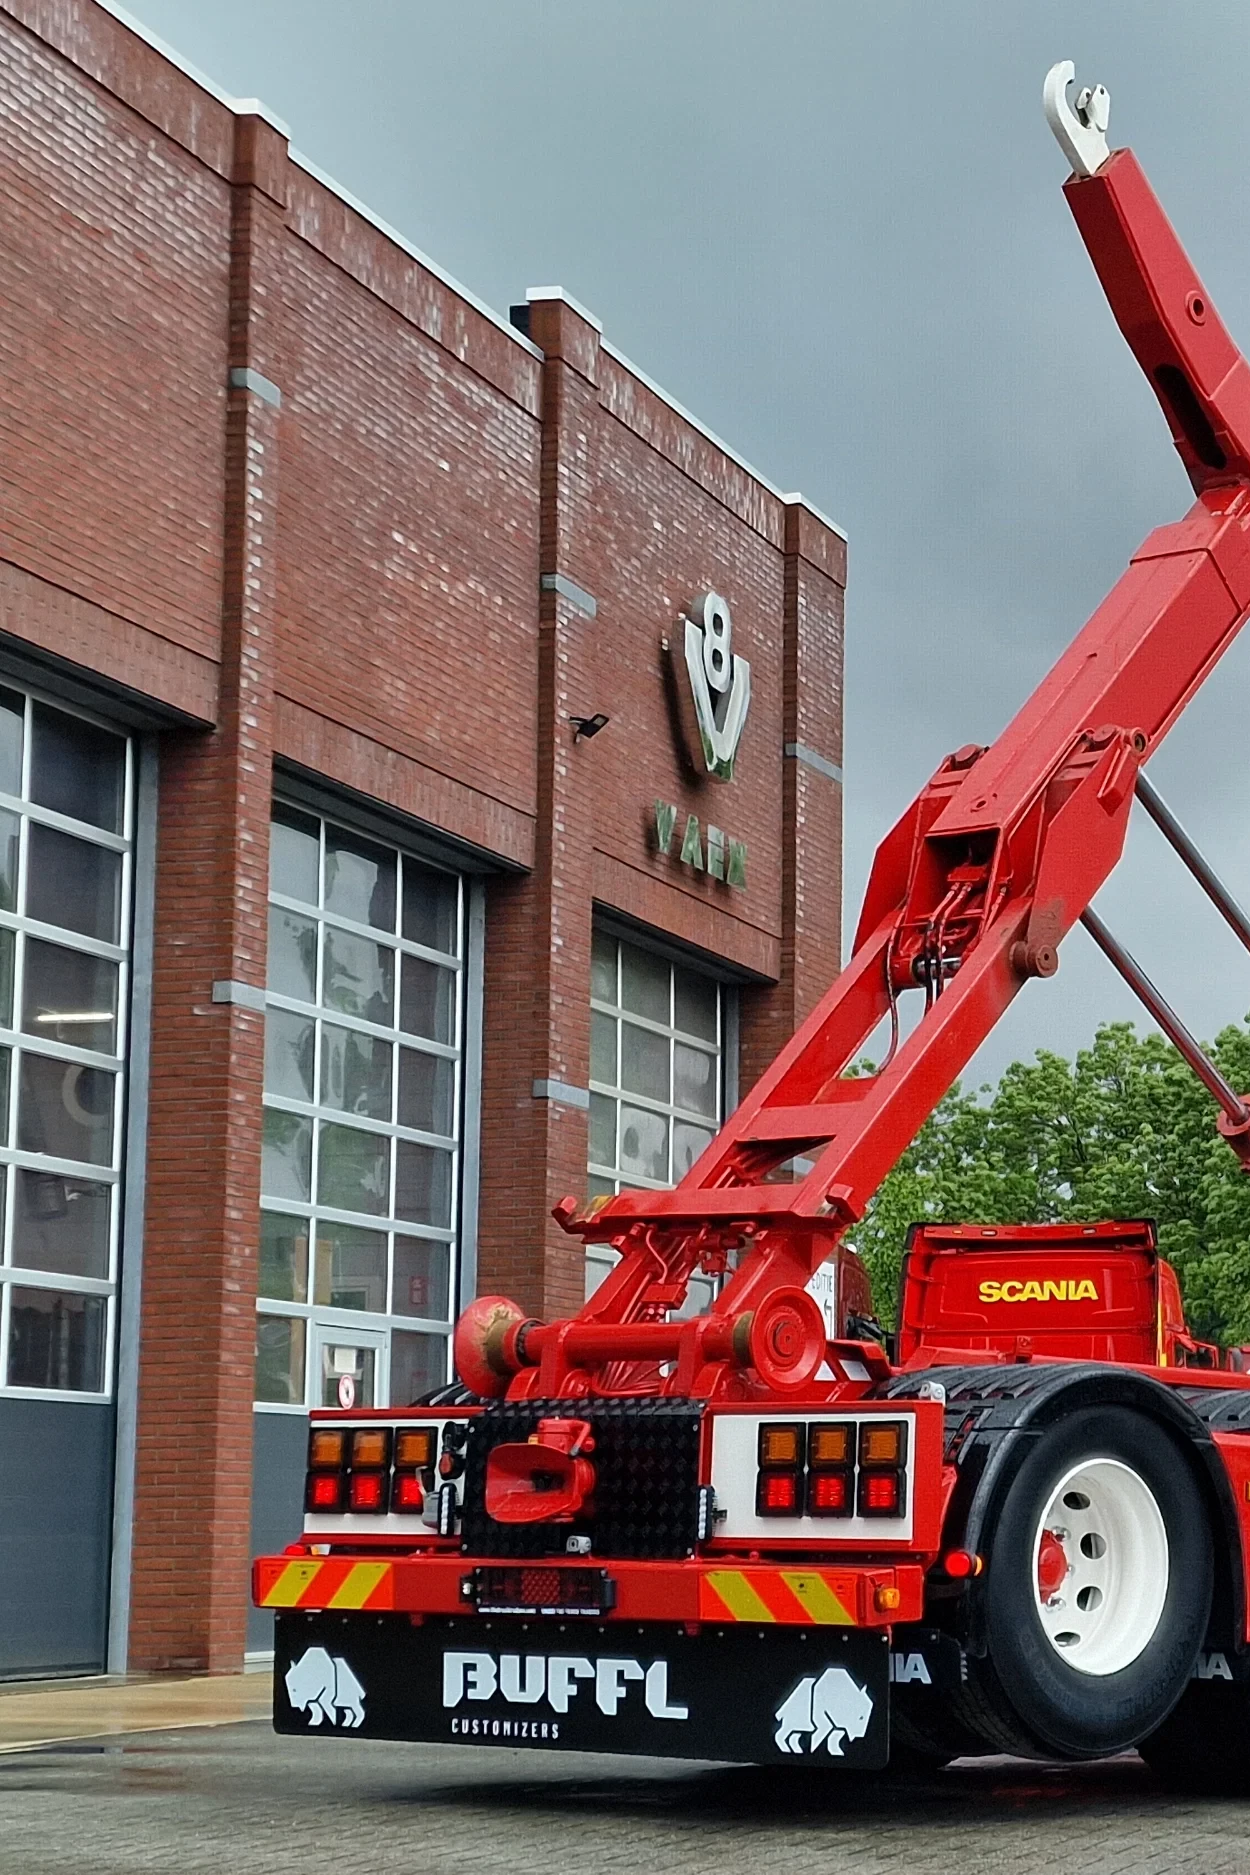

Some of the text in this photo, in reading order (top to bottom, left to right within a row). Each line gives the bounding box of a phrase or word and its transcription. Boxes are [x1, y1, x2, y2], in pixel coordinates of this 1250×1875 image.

[978, 1280, 1099, 1303] SCANIA
[443, 1651, 689, 1720] BUFFL
[451, 1717, 559, 1740] CUSTOMIZERS
